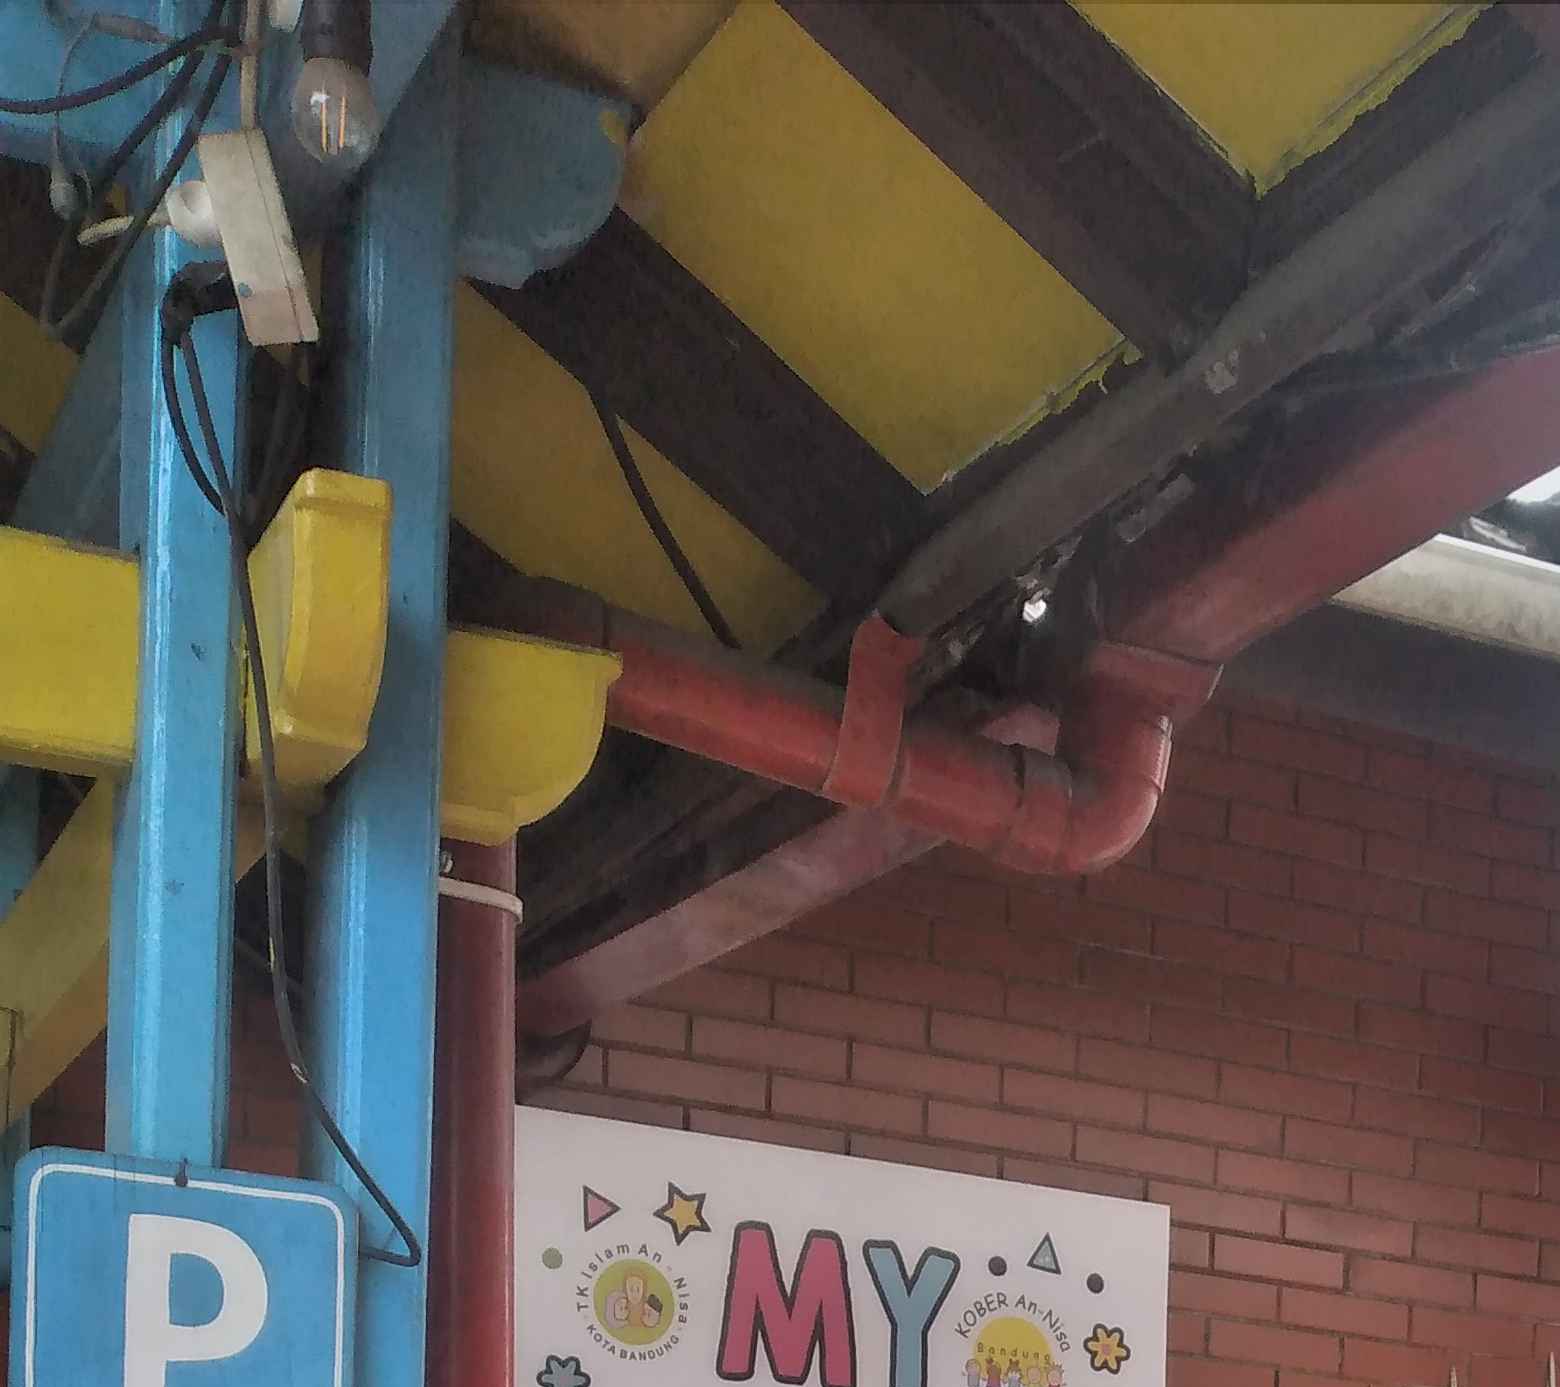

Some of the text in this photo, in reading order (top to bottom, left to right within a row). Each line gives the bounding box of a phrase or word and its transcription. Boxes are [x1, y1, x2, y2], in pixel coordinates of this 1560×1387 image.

[582, 1243, 630, 1279] Islam
[576, 1286, 589, 1312] TK
[954, 1292, 1071, 1352] KOBER An-Nisa
[587, 1323, 680, 1361] KOTA BANDUNG
[977, 1342, 1051, 1365] Bandung
